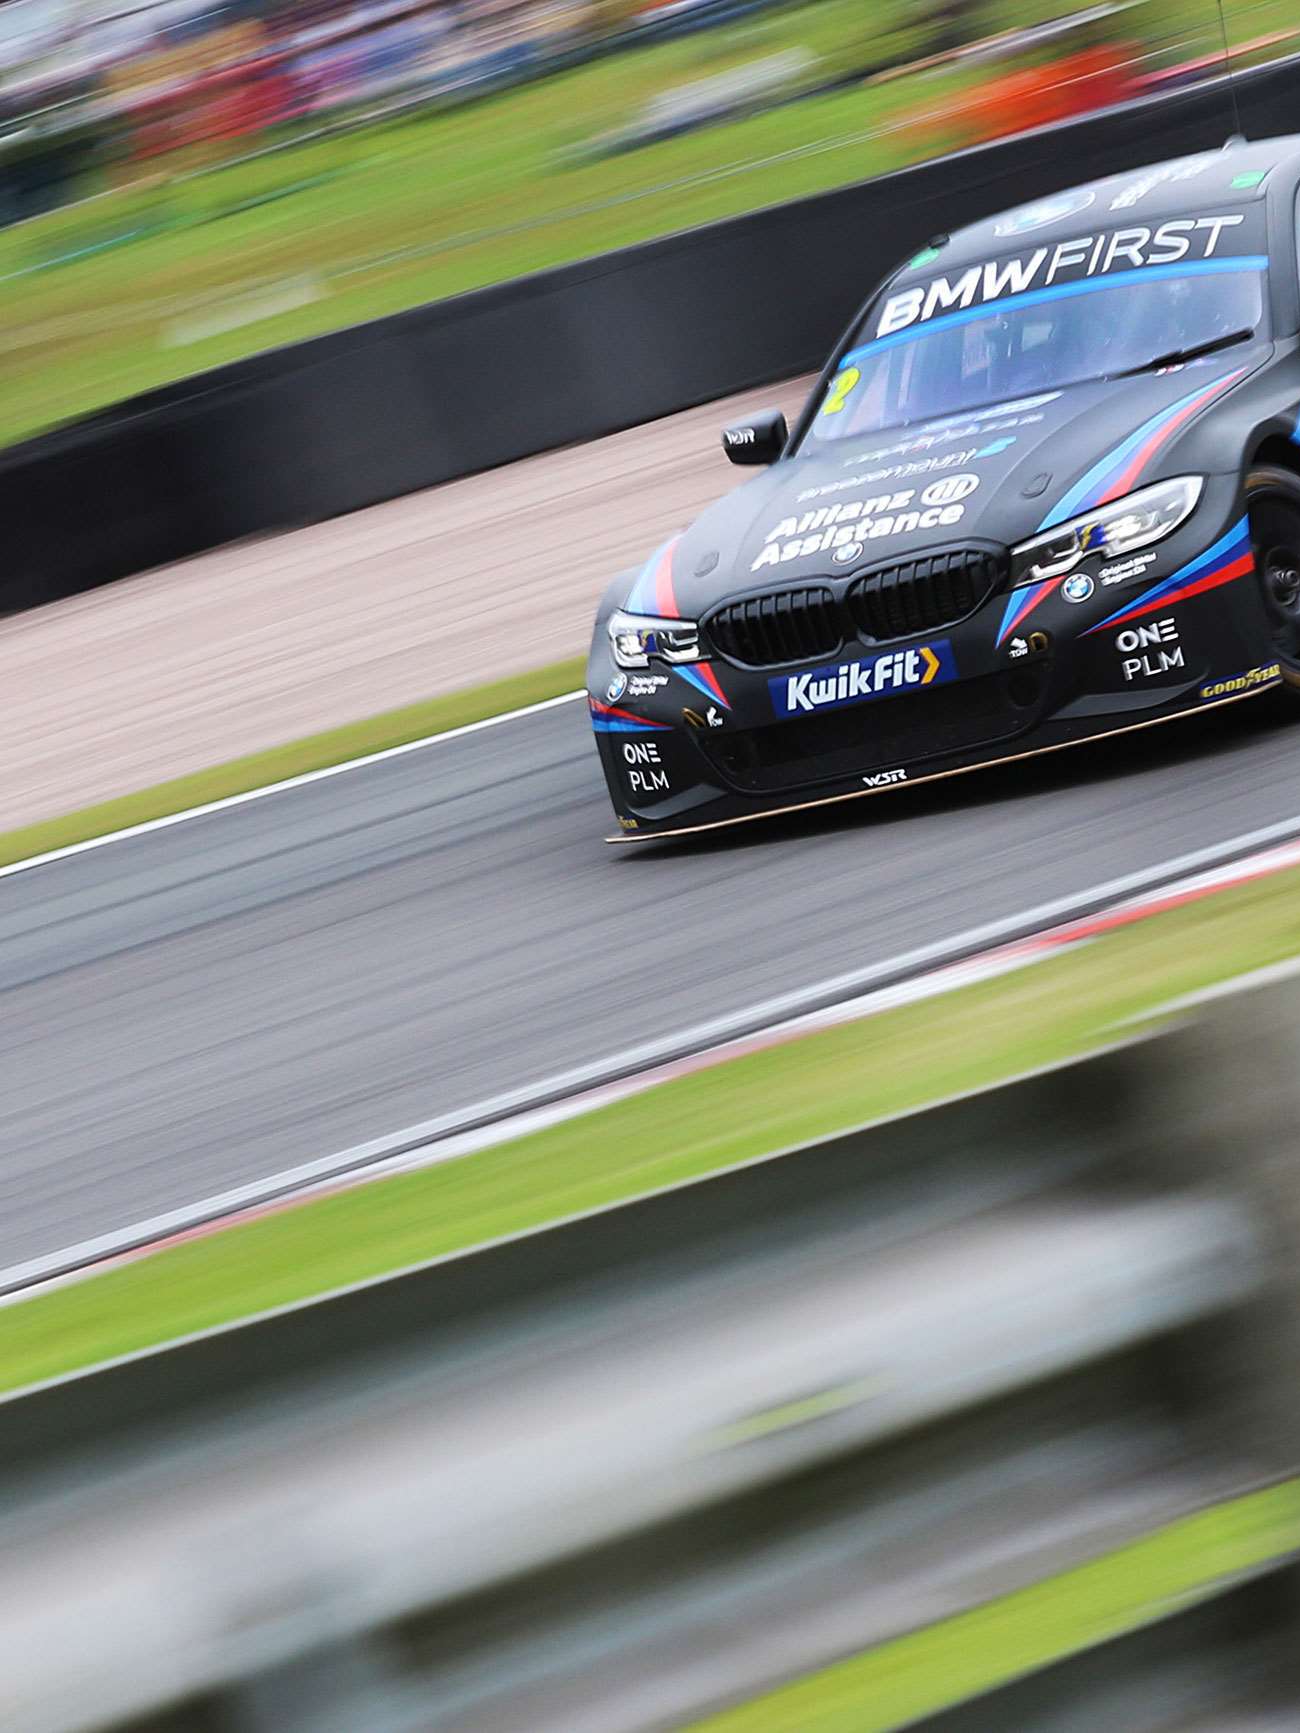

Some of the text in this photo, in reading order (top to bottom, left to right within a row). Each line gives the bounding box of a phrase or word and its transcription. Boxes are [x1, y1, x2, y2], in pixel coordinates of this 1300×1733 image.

[764, 489, 916, 544] Allianz
[750, 504, 966, 572] Assistance
[1115, 617, 1179, 652] ONE
[1121, 646, 1185, 681] PLM
[1202, 663, 1281, 699] GOODYEAR
[623, 742, 662, 764] ONE
[629, 770, 670, 791] PLM
[862, 768, 908, 787] WSR
